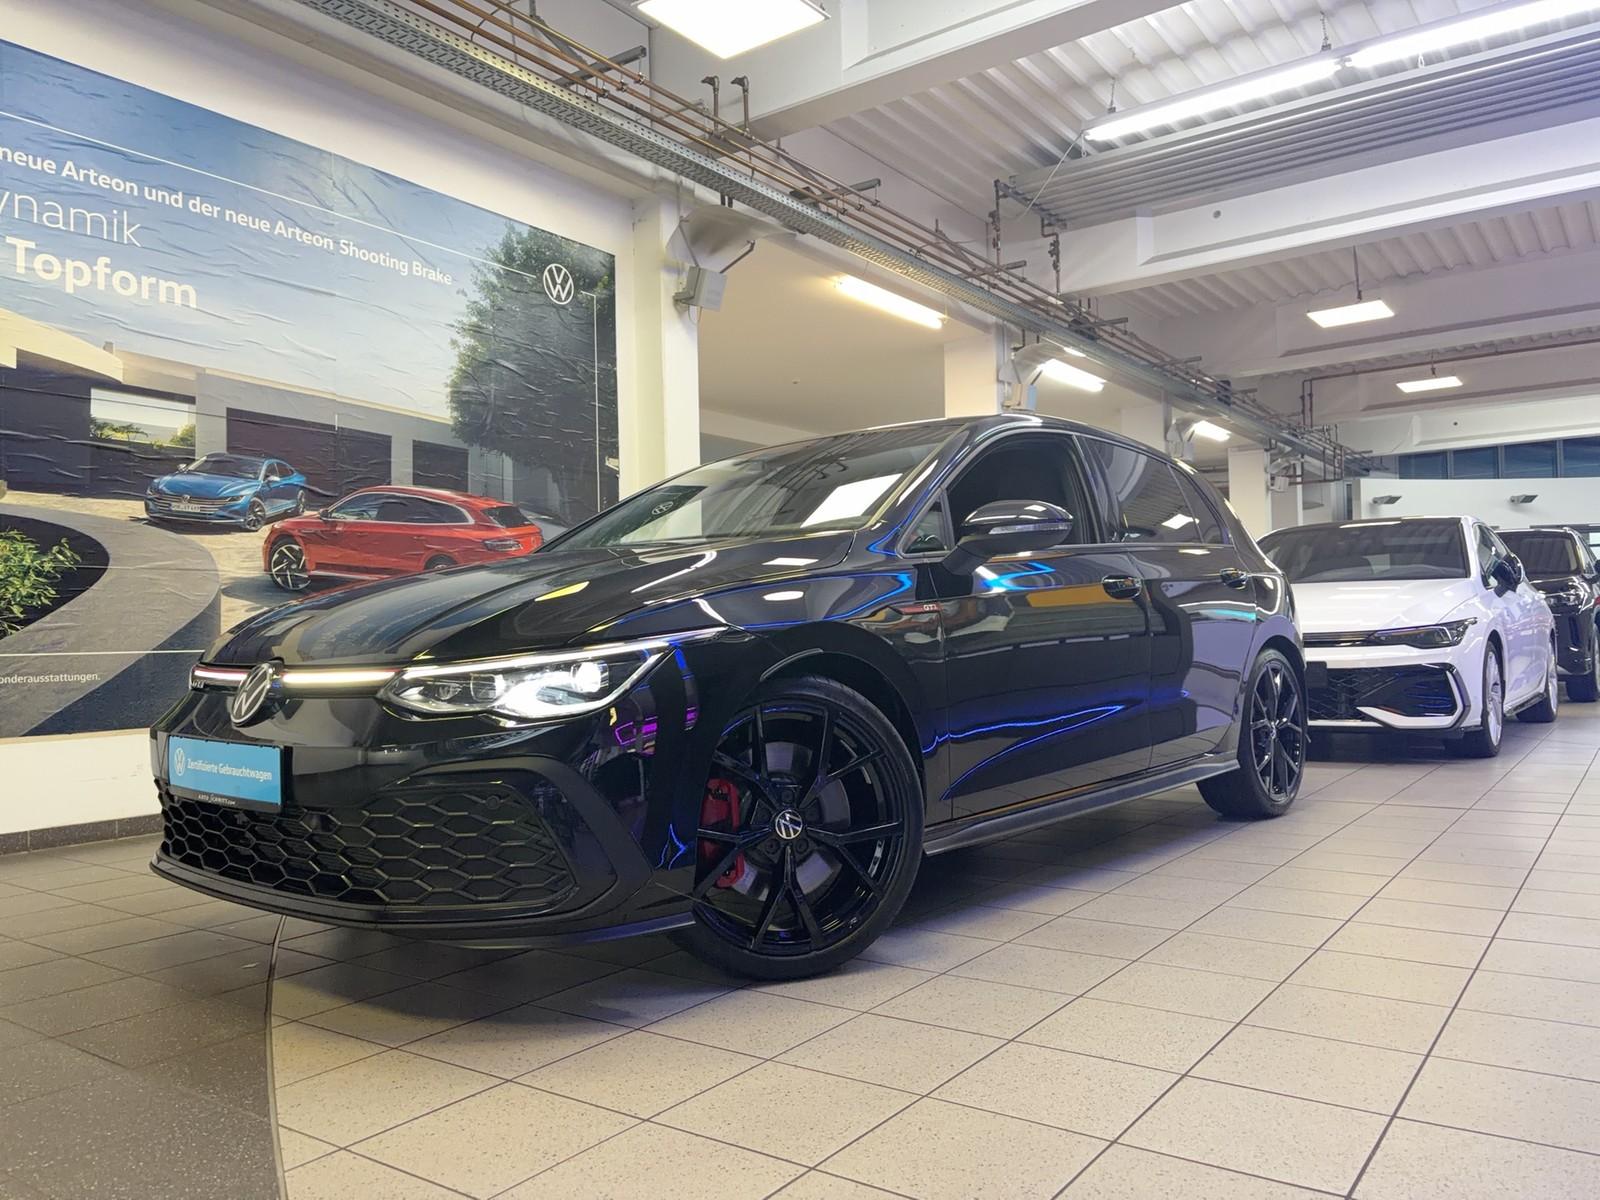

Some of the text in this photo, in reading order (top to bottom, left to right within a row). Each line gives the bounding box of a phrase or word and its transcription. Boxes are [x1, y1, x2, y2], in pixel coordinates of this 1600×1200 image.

[0, 147, 453, 285] neue Arteon und der neue Arteon Shooting Brake
[5, 236, 198, 308] Topform
[218, 763, 273, 782] Gebrauchtwagen
